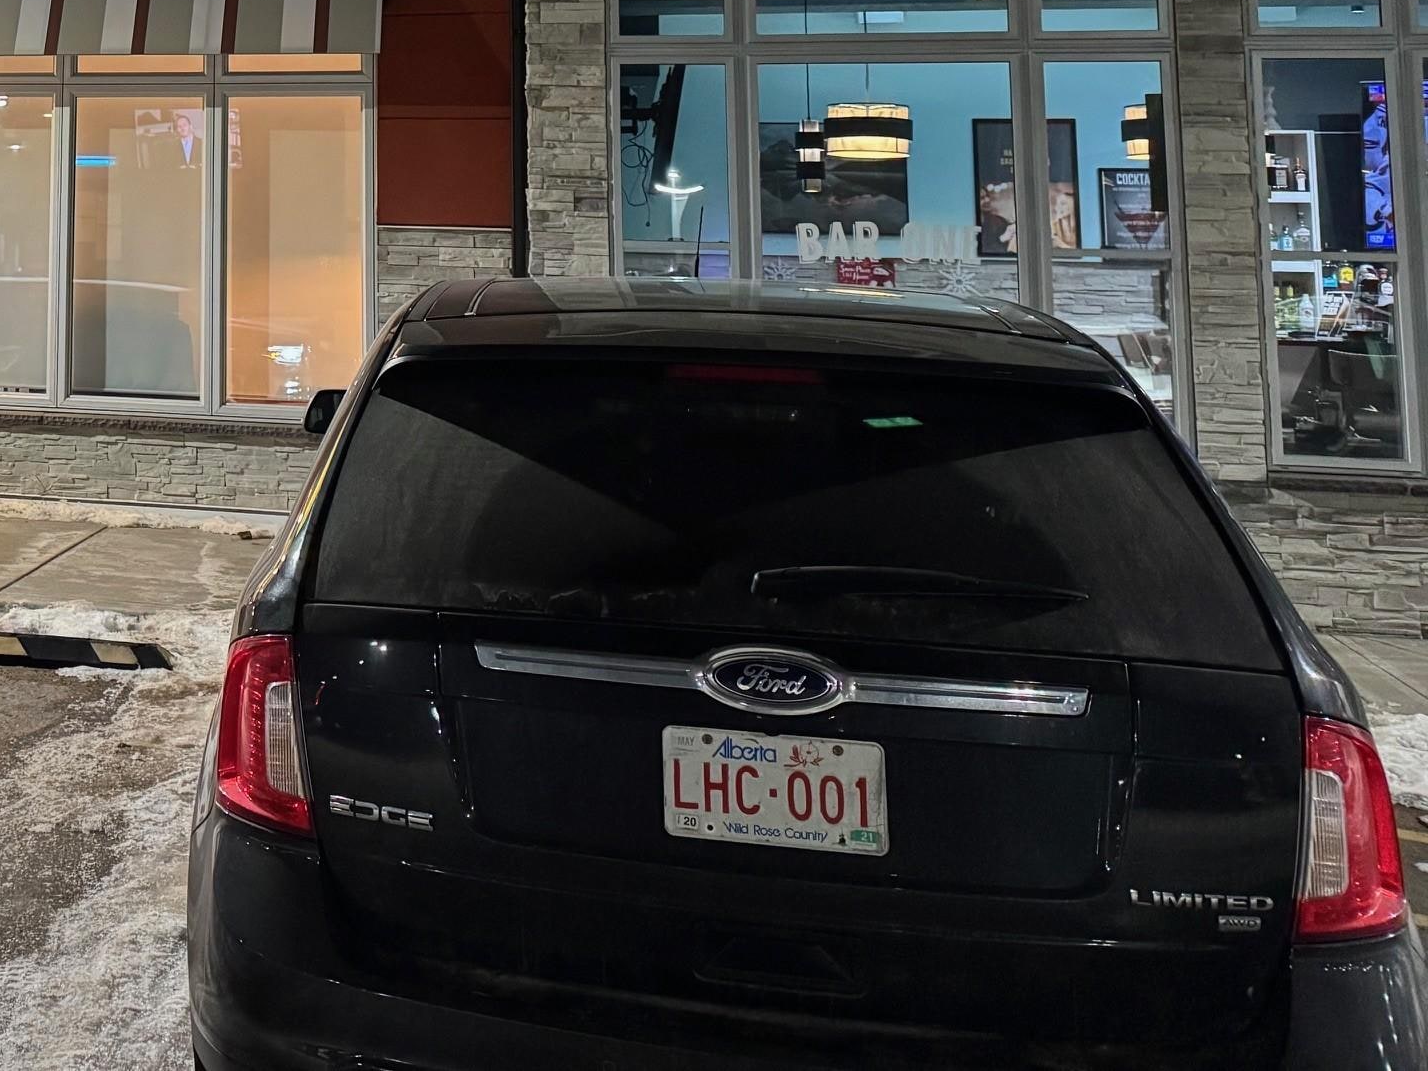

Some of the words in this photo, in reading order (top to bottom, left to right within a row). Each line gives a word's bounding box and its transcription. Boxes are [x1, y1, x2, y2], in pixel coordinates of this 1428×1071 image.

[1116, 173, 1151, 185] COCKTA
[796, 221, 884, 264] BAR
[736, 663, 807, 695] Ford
[677, 736, 695, 746] MAY
[712, 736, 777, 763] Alberta
[330, 795, 434, 831] EDGE
[683, 816, 697, 827] 20
[723, 821, 749, 835] Wild
[754, 824, 781, 837] Rose
[784, 827, 829, 842] Country
[1129, 888, 1275, 911] LIMITED
